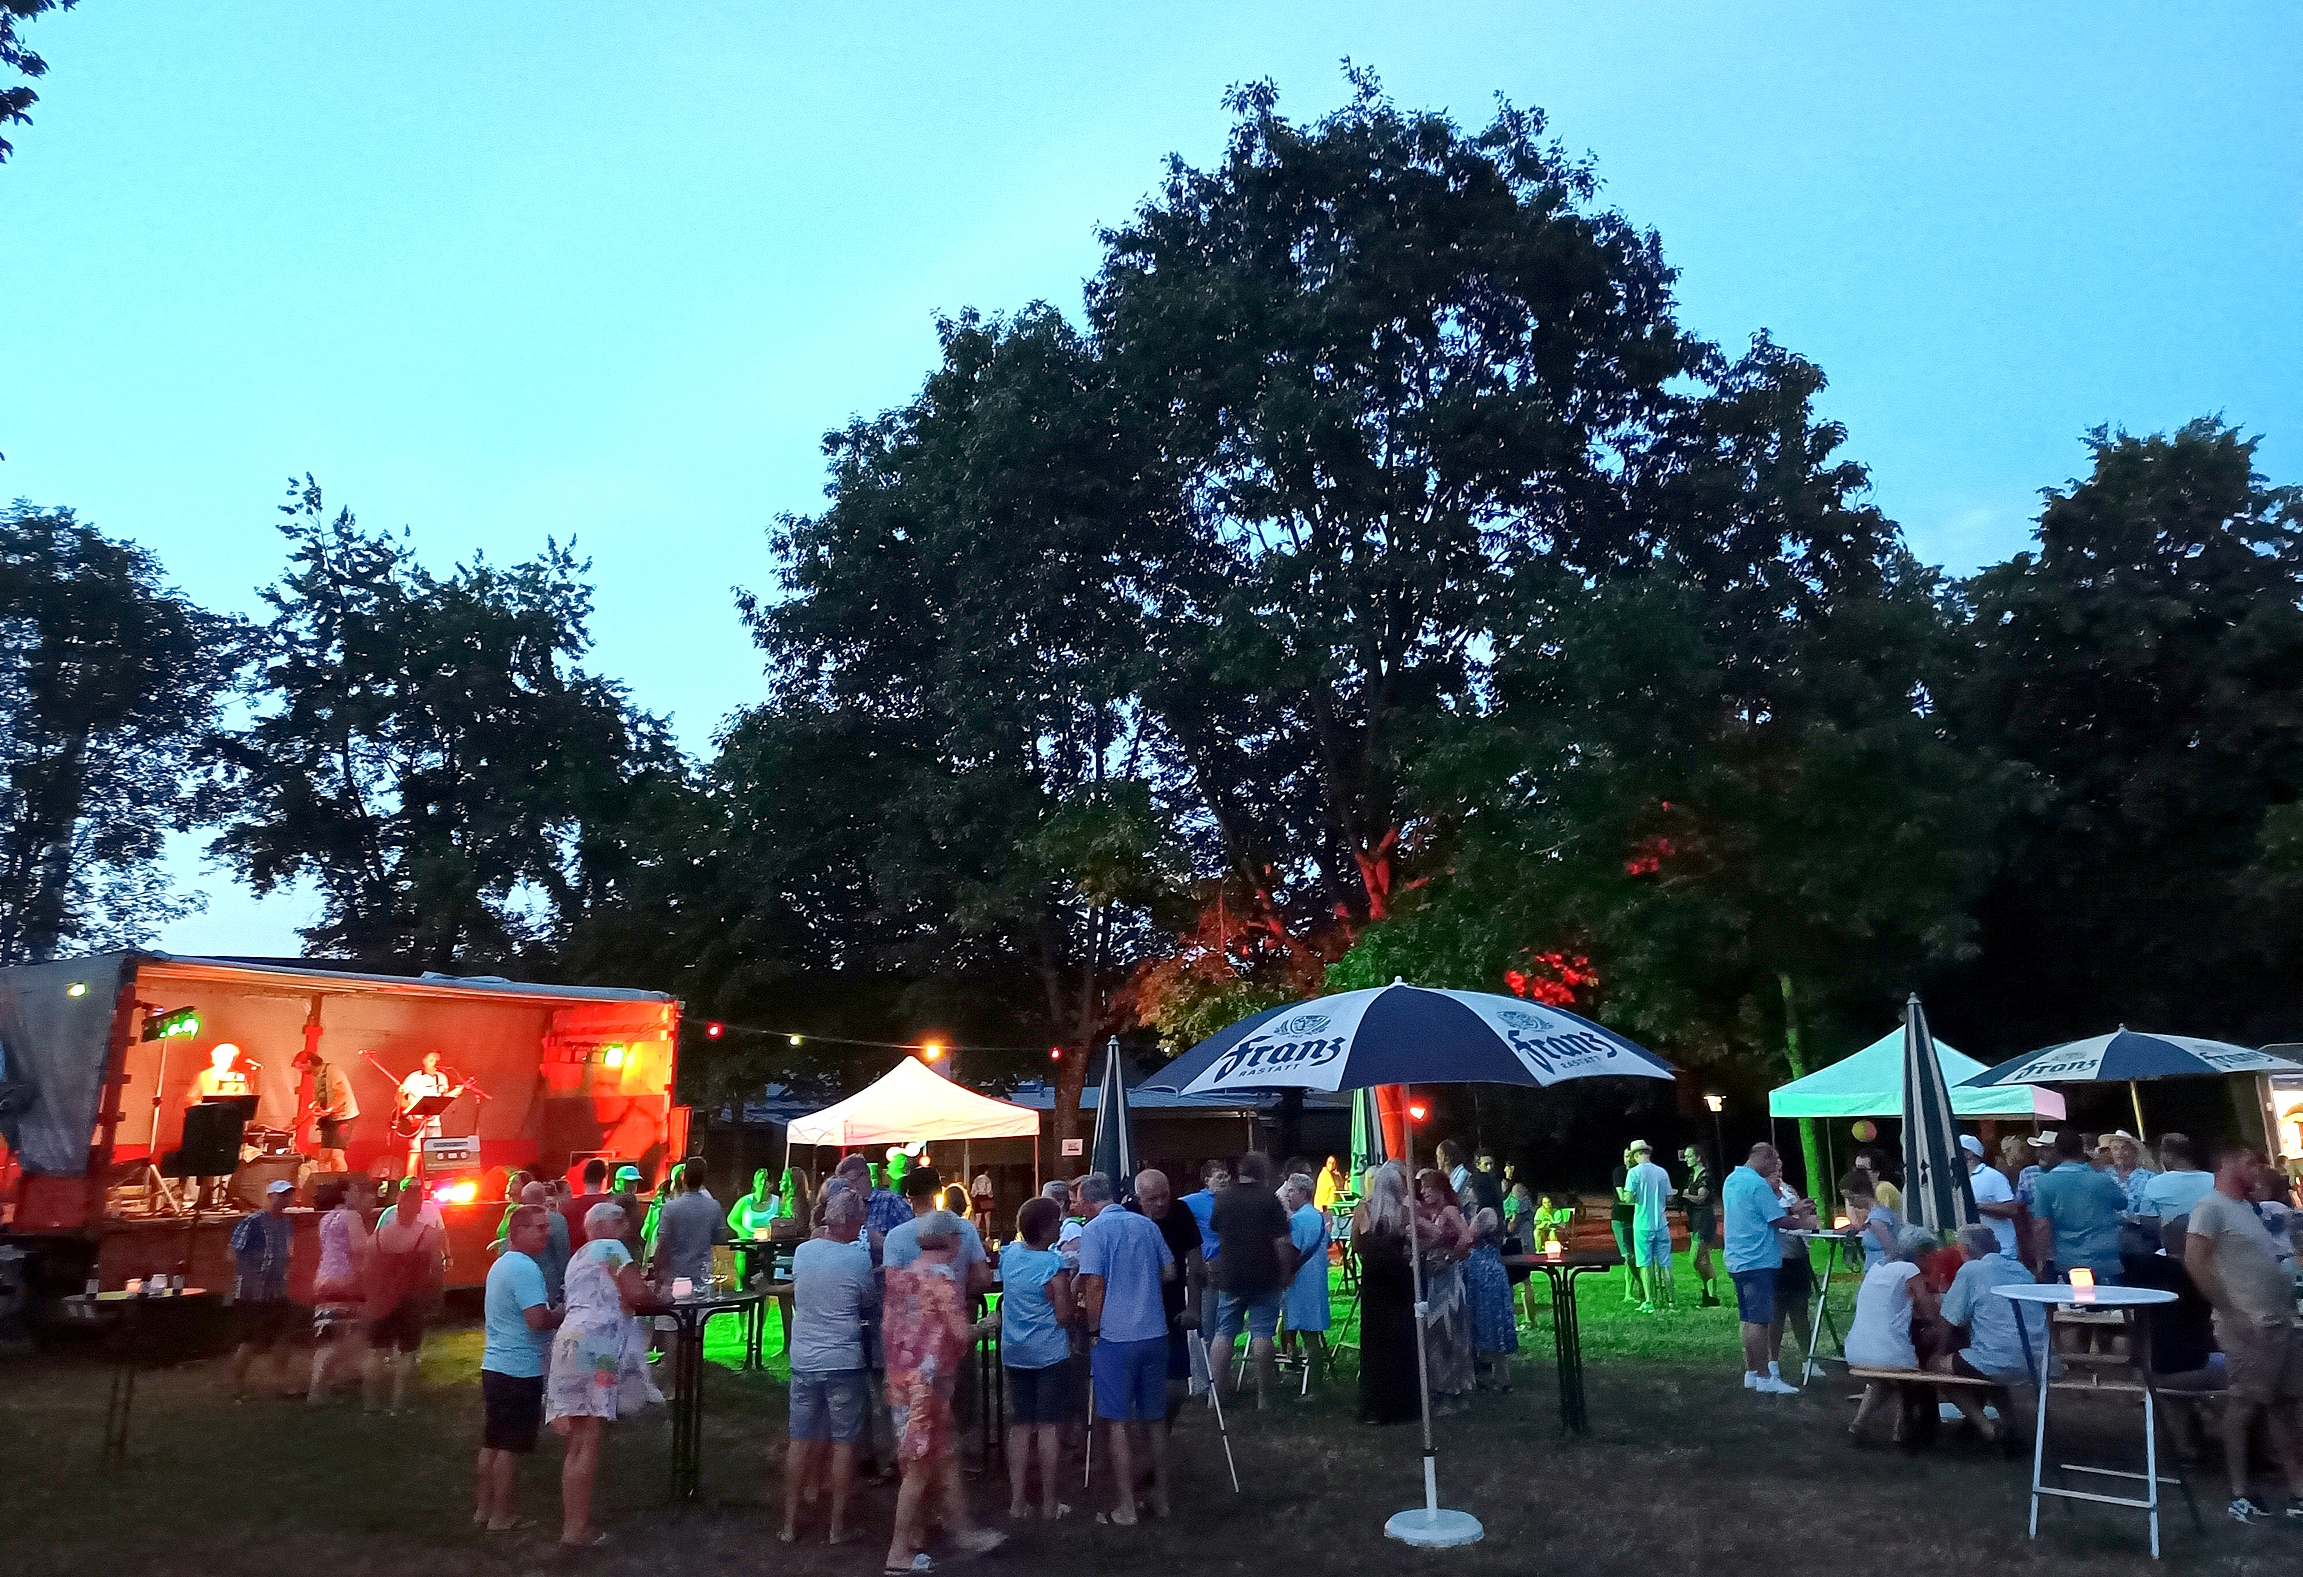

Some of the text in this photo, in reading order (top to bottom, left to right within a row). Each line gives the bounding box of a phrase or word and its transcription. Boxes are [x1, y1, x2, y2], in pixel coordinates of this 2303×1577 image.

[1213, 1035, 1347, 1084] Franz
[1507, 1030, 1618, 1075] Franz
[1560, 1055, 1600, 1069] RASTATT
[1237, 1063, 1300, 1078] RASTATT
